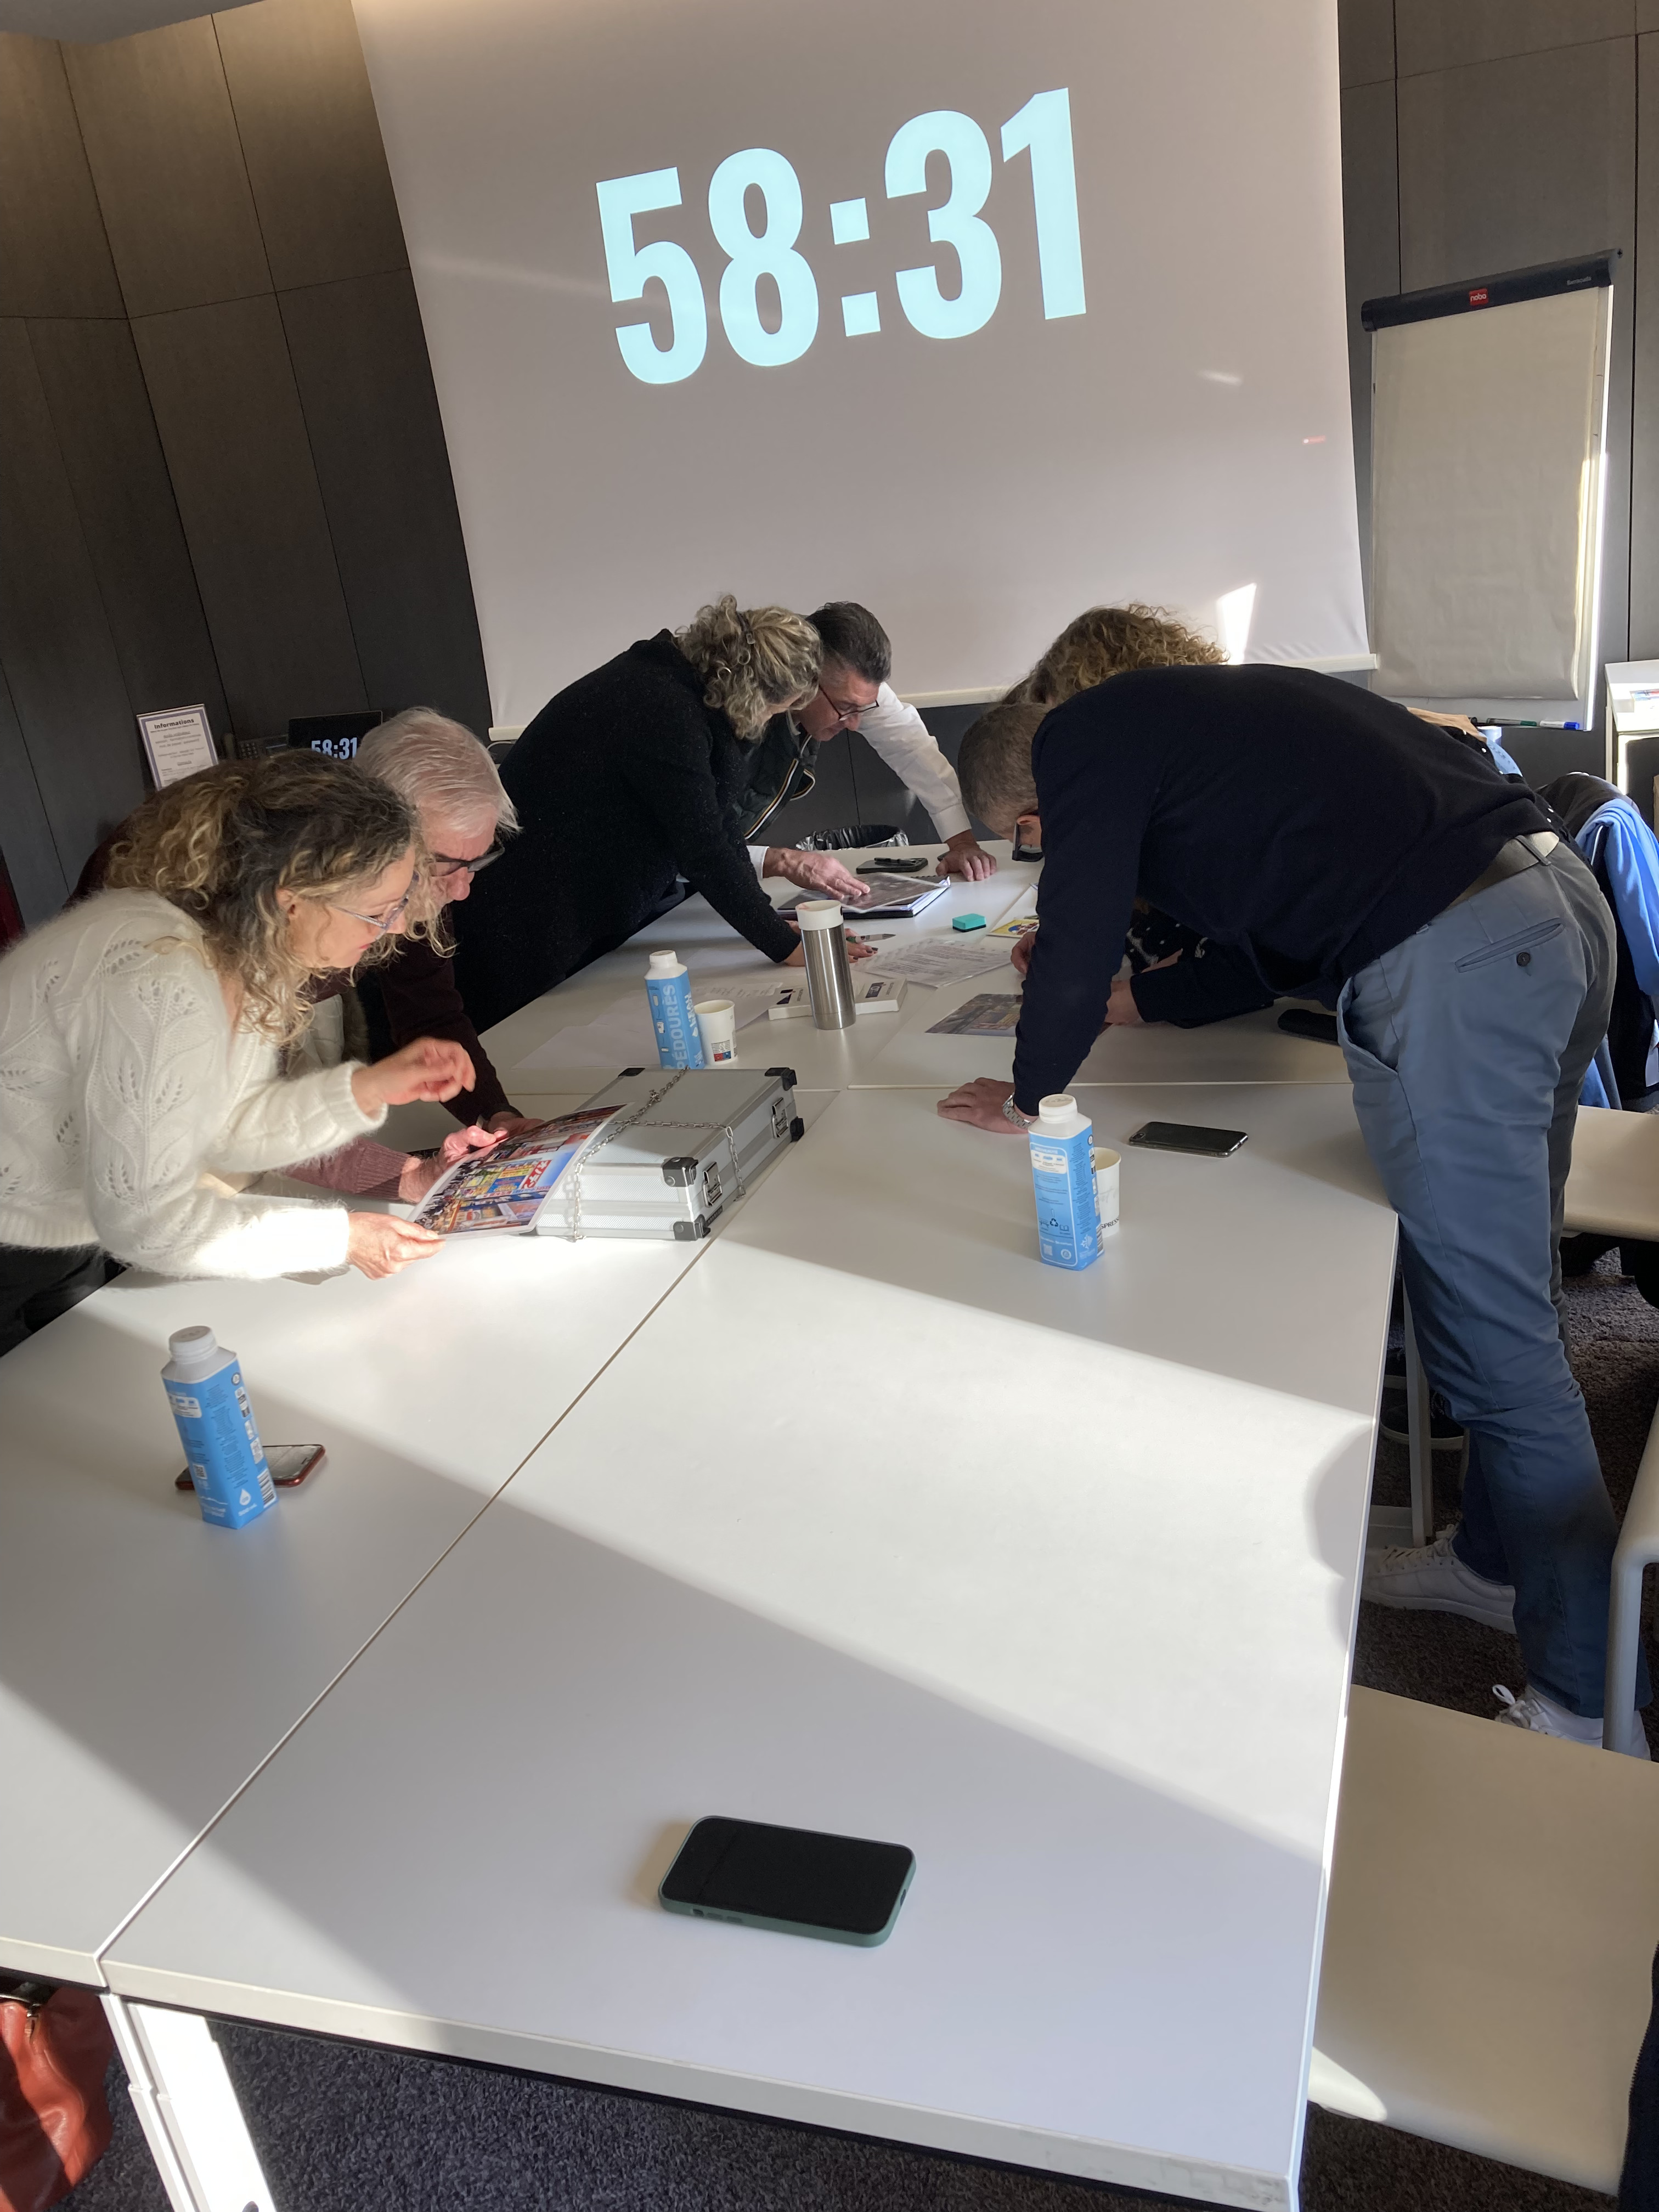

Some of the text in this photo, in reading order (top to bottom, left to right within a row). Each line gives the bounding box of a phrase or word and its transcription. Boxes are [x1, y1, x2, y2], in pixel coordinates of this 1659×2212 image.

[596, 88, 1086, 383] 58:31
[1470, 293, 1486, 302] nobo
[154, 719, 194, 729] Informations
[311, 737, 357, 759] 58:31
